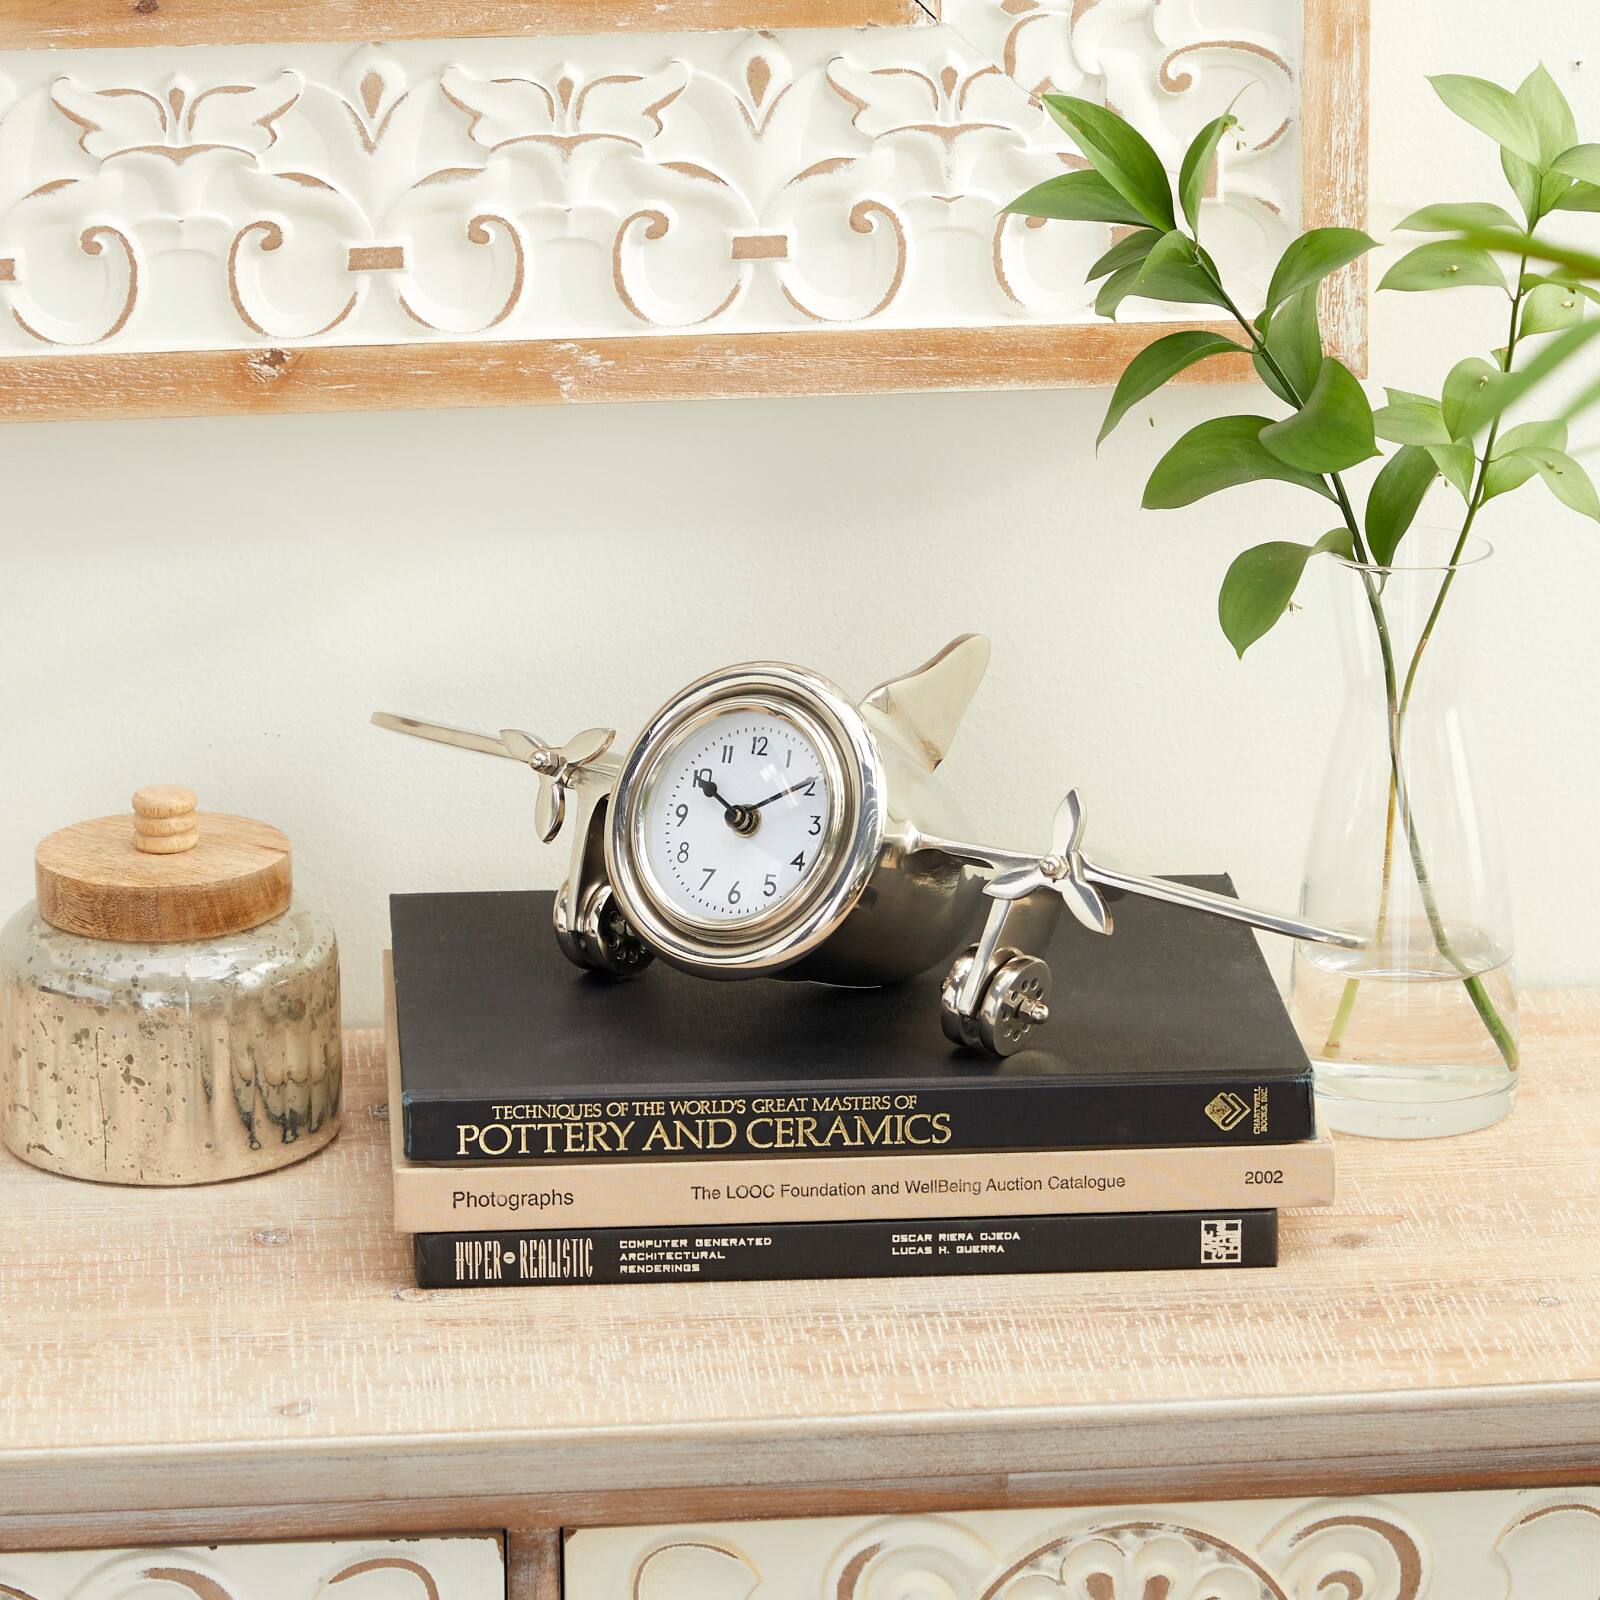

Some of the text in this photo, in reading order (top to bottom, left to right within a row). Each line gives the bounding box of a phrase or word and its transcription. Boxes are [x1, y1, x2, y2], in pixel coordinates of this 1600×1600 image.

[721, 745, 734, 764] 11
[751, 736, 768, 756] 12
[785, 749, 792, 768] 1
[675, 803, 689, 827] 9
[808, 815, 821, 836] 3
[677, 841, 690, 864] 8
[789, 850, 806, 872] 4
[699, 867, 717, 891] 7
[762, 873, 777, 897] 5
[727, 880, 741, 905] 6
[491, 1094, 918, 1121] TECHNIQUES OF THE WORLD'S GREAT MASTERS OF
[1253, 1086, 1261, 1135] CHARTWELL
[456, 1113, 952, 1156] POTTERY AND CERAMICS
[691, 1174, 1126, 1200] The LOOC Foundation and WellBeing Auction Catalogue
[1244, 1170, 1283, 1184] 2002
[452, 1189, 574, 1210] Photographs
[619, 1237, 772, 1249] COMPUTER GENERATED
[892, 1231, 1021, 1243] OSCAR RIERA OJEDA
[619, 1251, 725, 1261] ARCHITECTURAL
[892, 1245, 1005, 1256] LUCAS H. GUERRA
[619, 1264, 700, 1274] RENDERINGS
